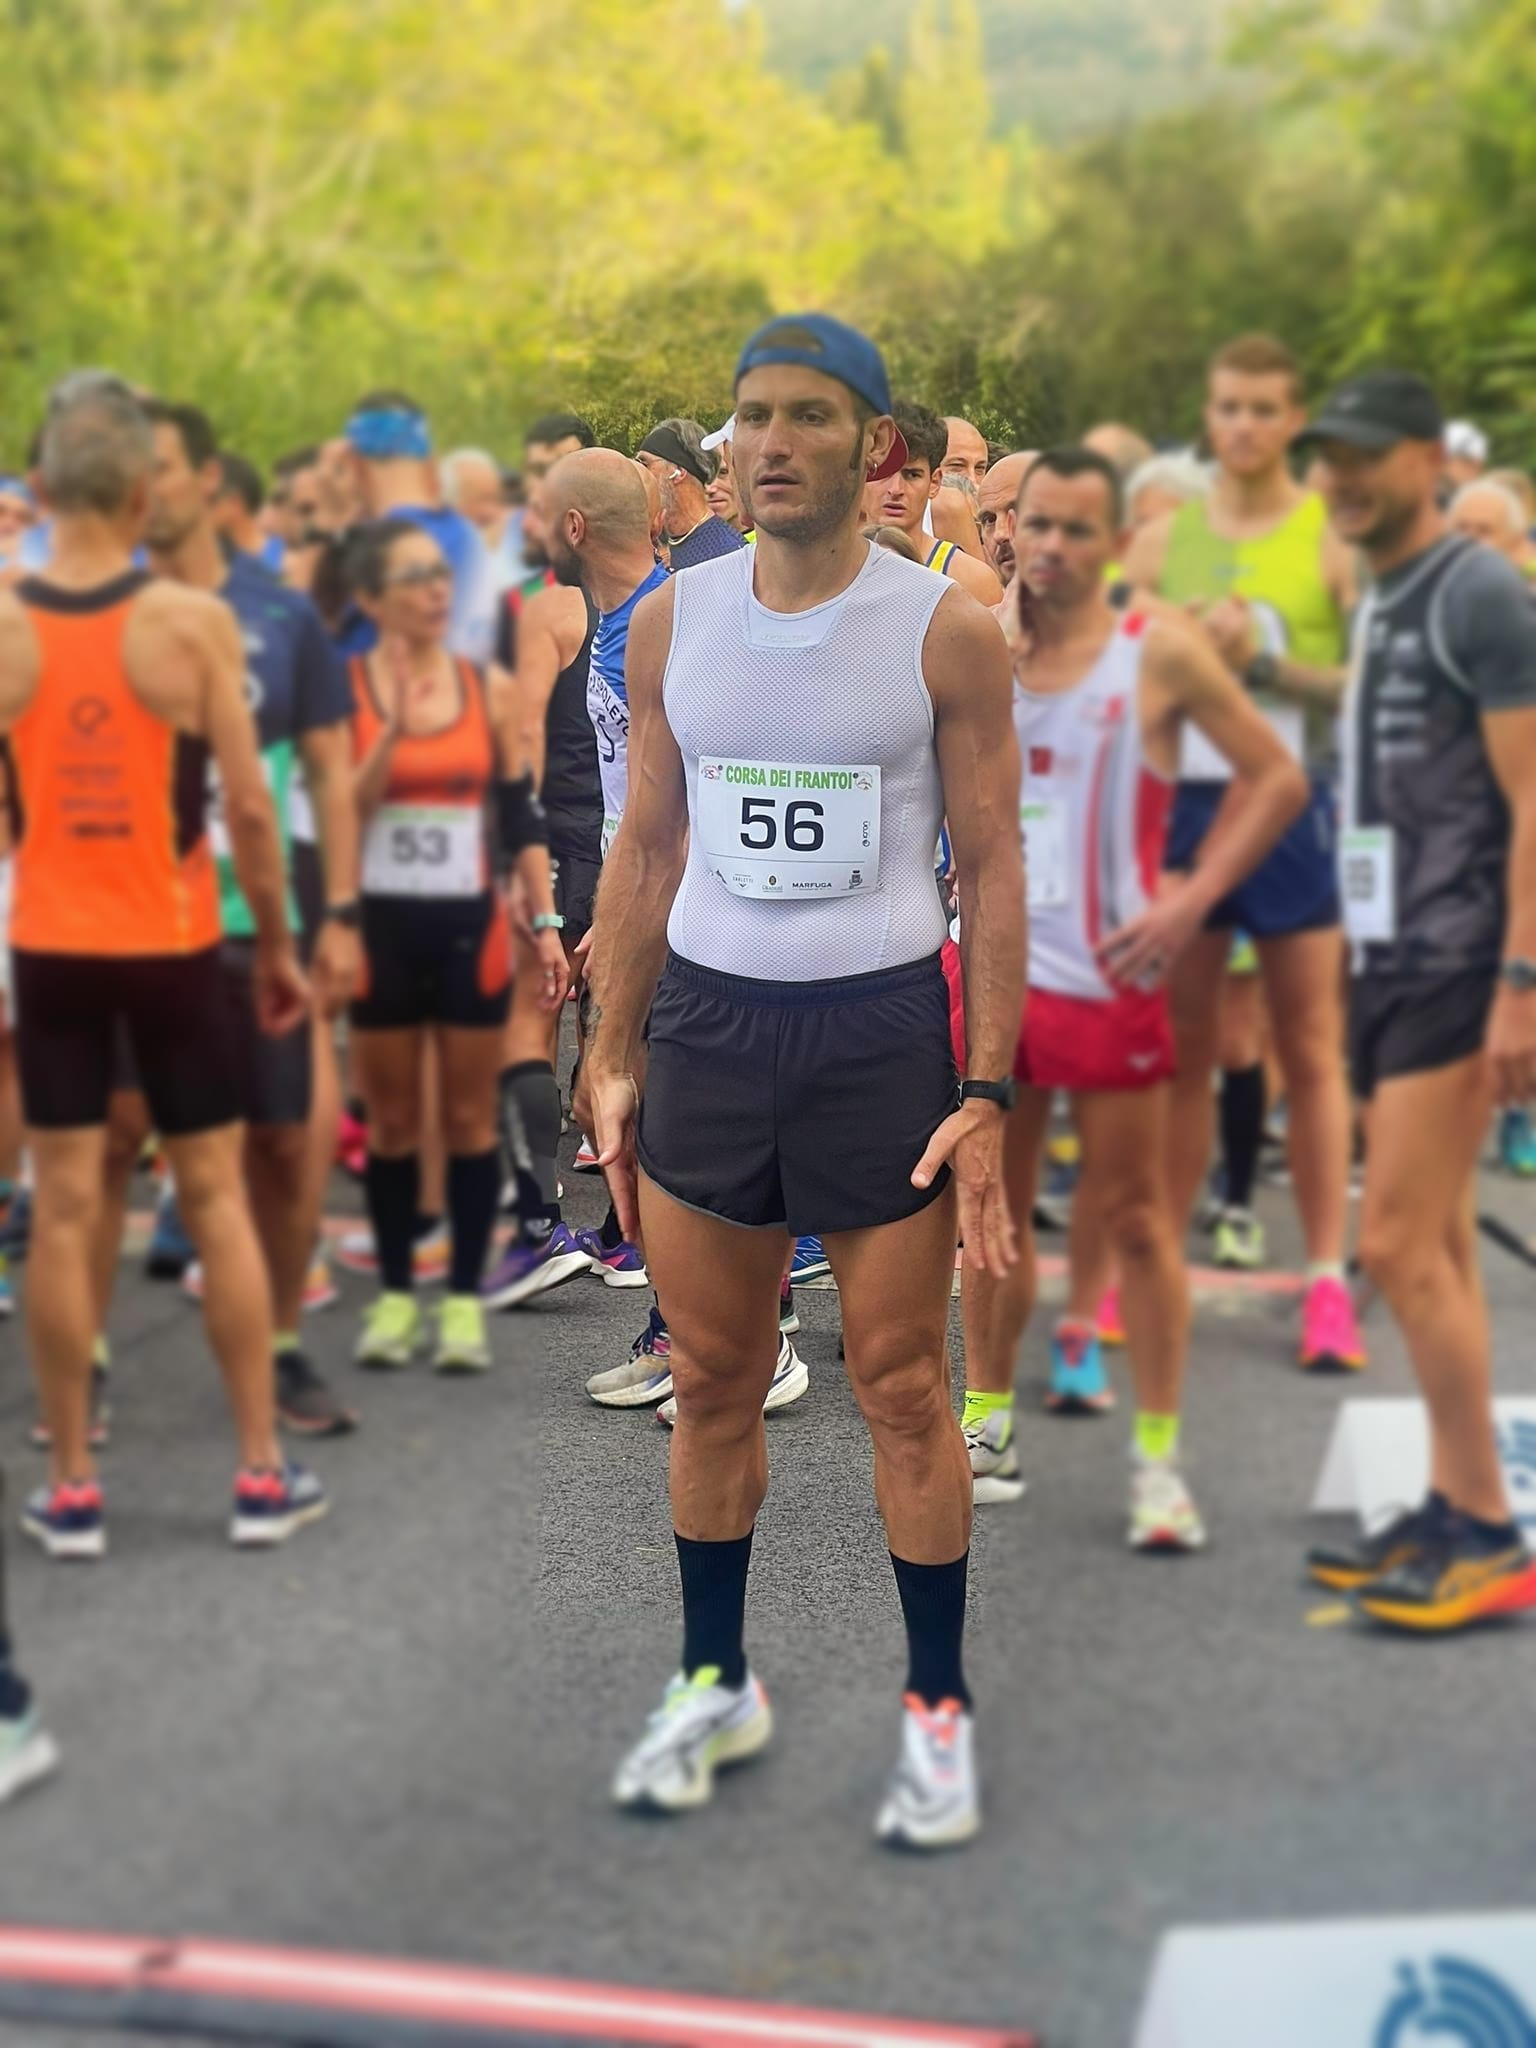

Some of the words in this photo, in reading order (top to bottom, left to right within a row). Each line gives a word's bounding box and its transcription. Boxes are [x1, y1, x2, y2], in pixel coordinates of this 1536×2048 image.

[726, 765, 766, 786] CORSA
[770, 769, 791, 788] DEI
[795, 771, 853, 790] FRANTOI
[740, 797, 824, 852] 56
[391, 826, 450, 869] 53
